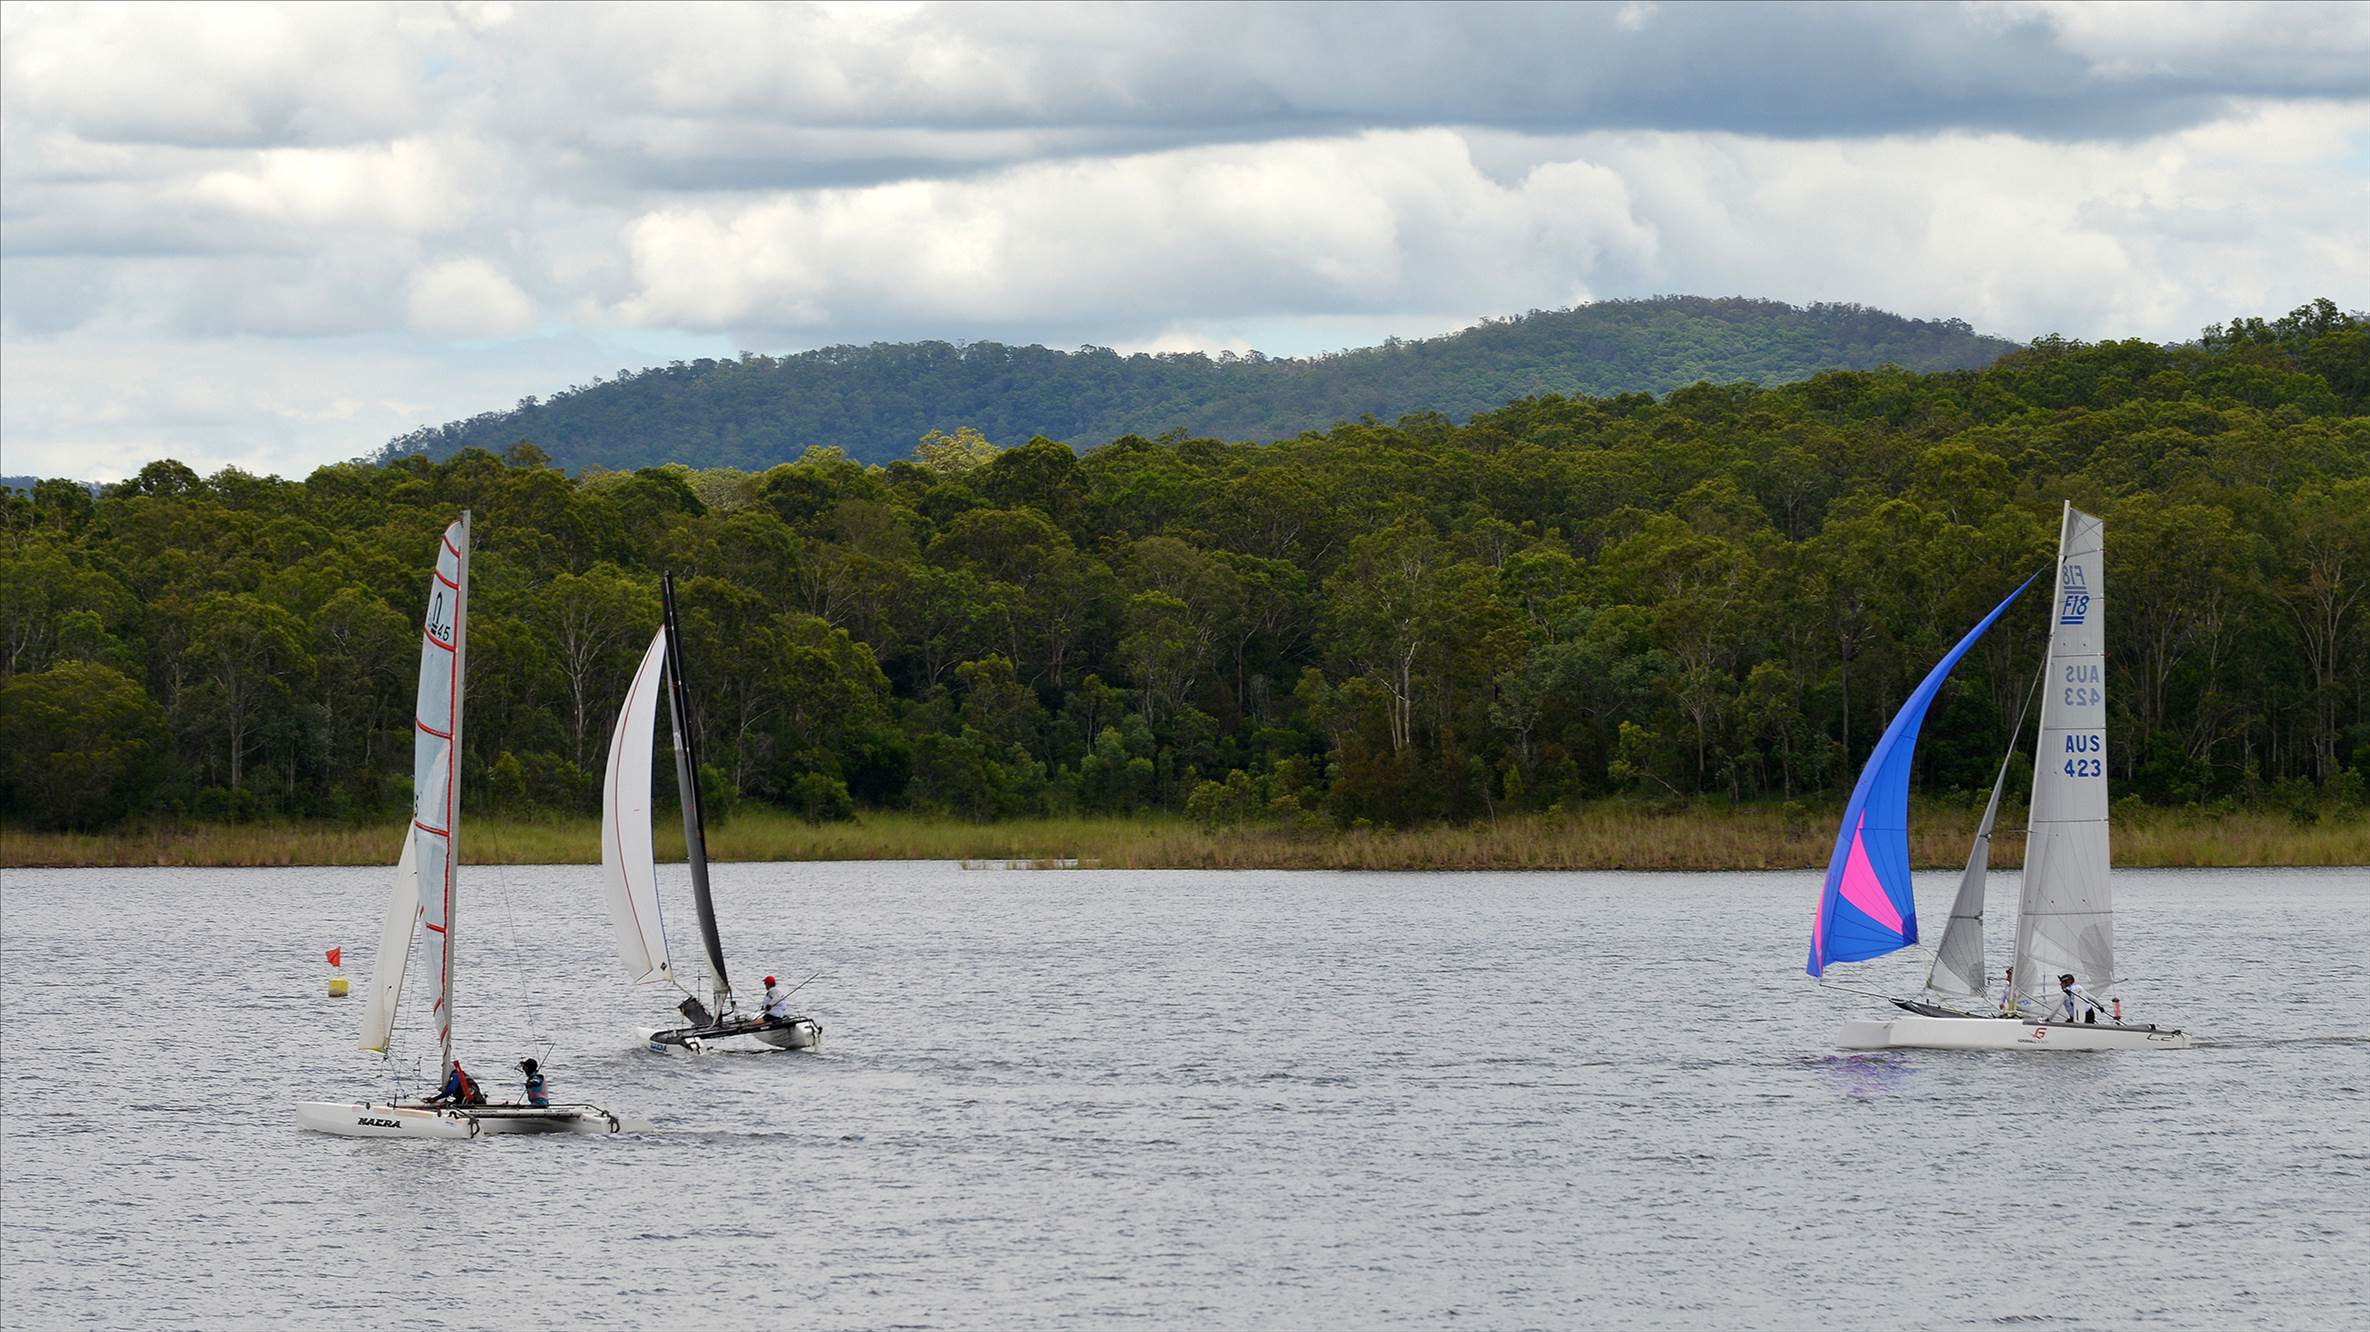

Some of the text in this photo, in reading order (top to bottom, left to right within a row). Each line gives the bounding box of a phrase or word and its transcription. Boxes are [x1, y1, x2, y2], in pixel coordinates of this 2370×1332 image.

[2062, 595, 2090, 615] F18
[2065, 734, 2101, 754] AUS
[2063, 758, 2101, 778] 423
